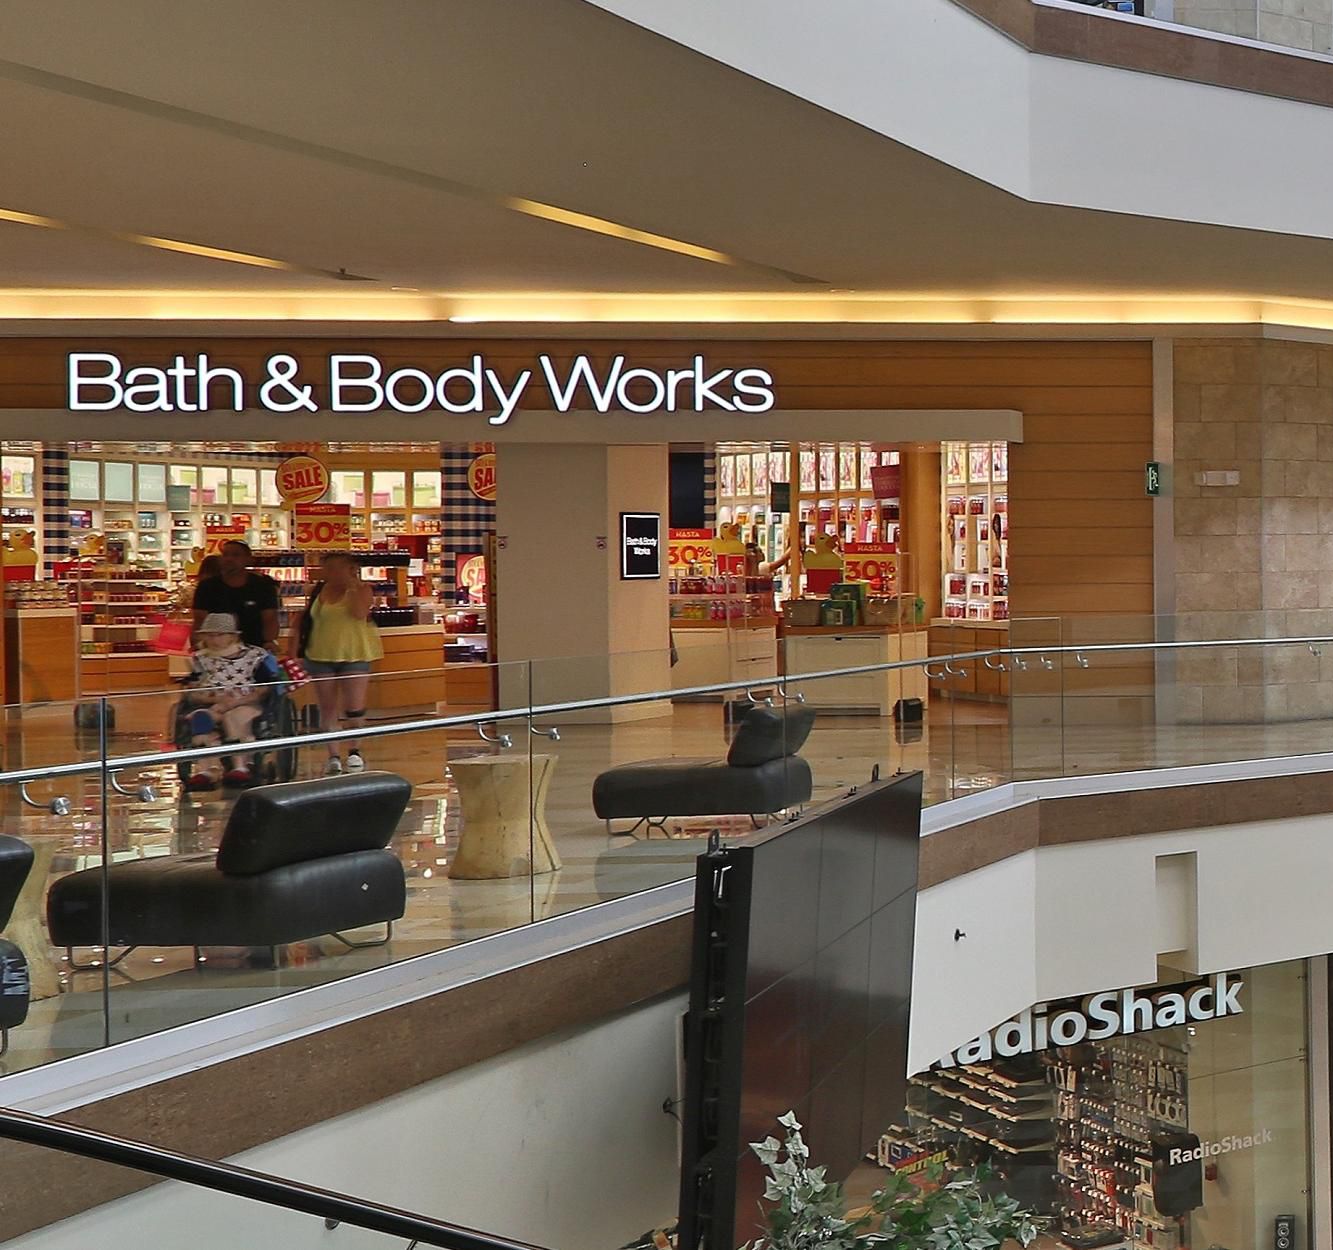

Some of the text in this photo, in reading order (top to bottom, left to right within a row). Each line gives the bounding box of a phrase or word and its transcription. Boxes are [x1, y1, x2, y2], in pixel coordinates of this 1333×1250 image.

[67, 352, 776, 426] Bath & Body Works
[282, 465, 324, 491] SALE
[296, 521, 350, 545] 30%
[668, 545, 713, 565] 30%
[844, 560, 897, 581] 30%
[928, 972, 1245, 1072] adioShack
[1169, 1127, 1272, 1166] RadioShack
